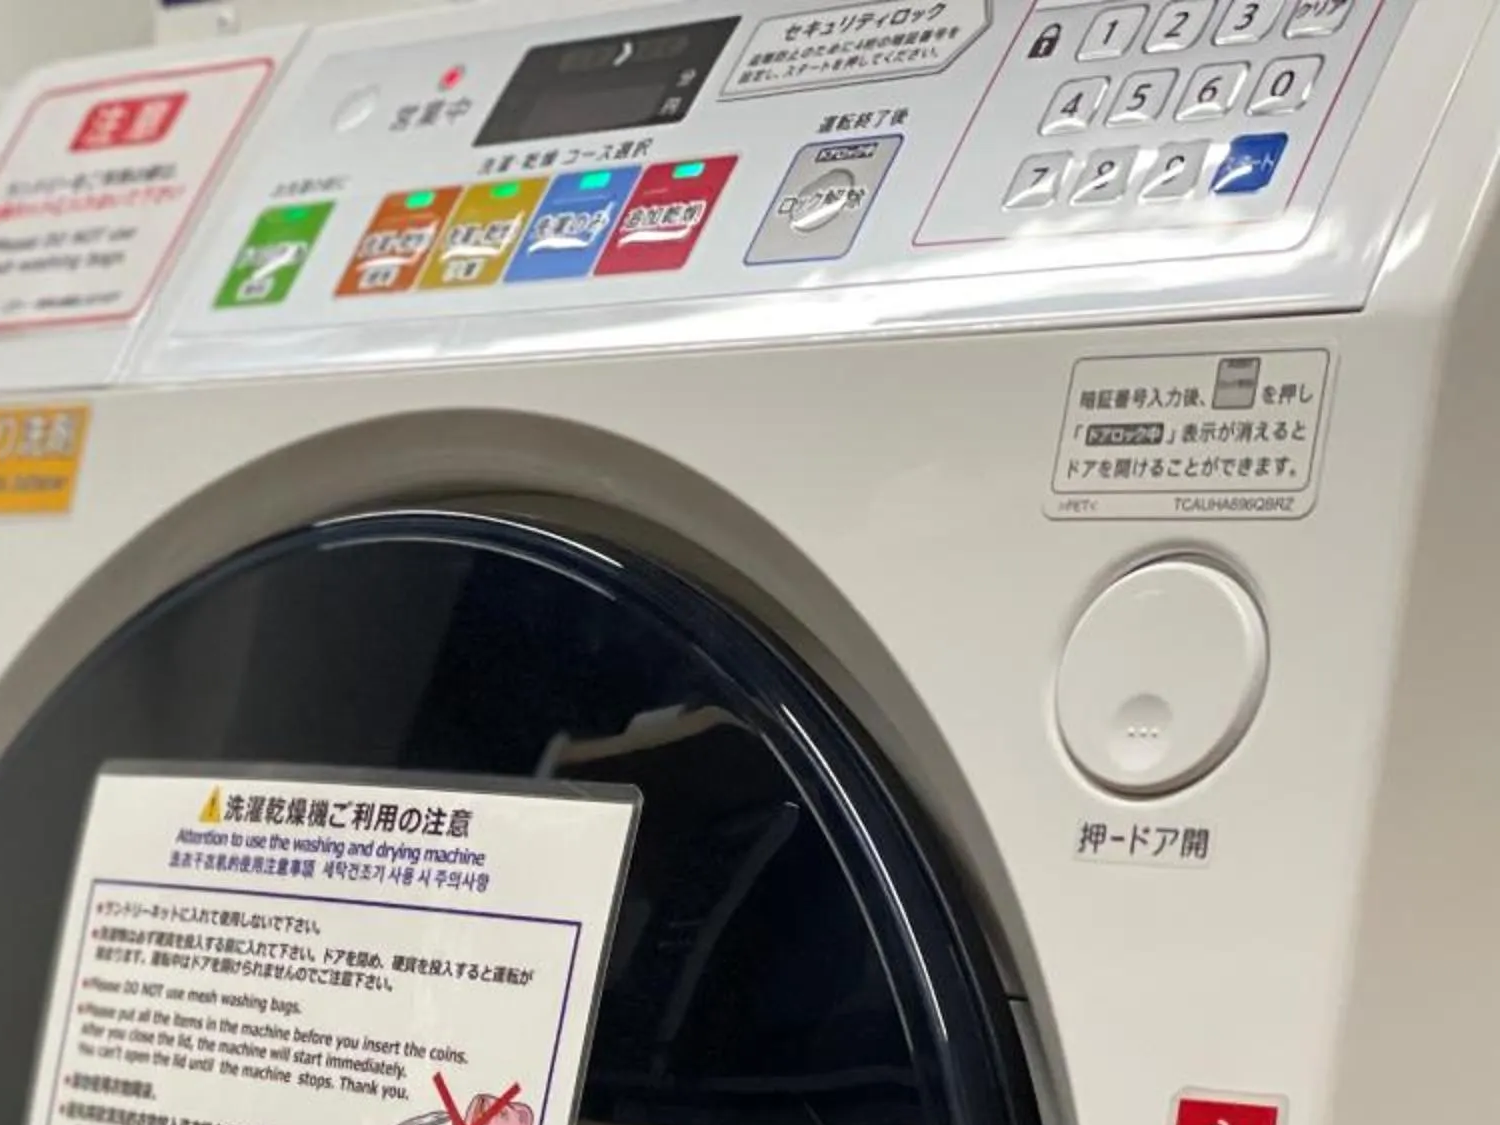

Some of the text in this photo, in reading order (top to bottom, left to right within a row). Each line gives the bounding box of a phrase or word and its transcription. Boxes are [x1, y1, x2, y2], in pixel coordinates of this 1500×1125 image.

[784, 2, 948, 42] セキュリティロック
[1164, 11, 1190, 38] 2
[1234, 2, 1260, 31] 3
[1102, 19, 1120, 45] 1
[1126, 82, 1152, 111] 5
[1197, 75, 1223, 104] 6
[1270, 69, 1295, 98] 0
[1059, 92, 1084, 117] 4
[1260, 383, 1314, 405] を押し
[1066, 457, 1297, 480] ドアを開けることができます。
[224, 794, 474, 838] 洗濯乾燥機ご利用の注意
[176, 829, 487, 867] Attention to use the washing and drying machine
[166, 986, 185, 1001] use
[187, 985, 217, 1004] mesh
[220, 990, 267, 1014] washing
[270, 997, 303, 1017] bags.
[153, 1008, 171, 1026] the
[206, 1014, 218, 1031] in
[220, 1015, 240, 1035] the
[241, 1019, 291, 1042] machine
[293, 1026, 333, 1047] before
[336, 1036, 360, 1052] you
[362, 1035, 402, 1057] insert
[404, 1040, 428, 1059] the
[429, 1045, 469, 1065] coins.
[157, 1029, 175, 1047] the
[197, 1034, 216, 1053] the
[218, 1036, 267, 1059] machine
[269, 1042, 291, 1063] will
[293, 1049, 323, 1068] start
[325, 1052, 408, 1080] immediately.
[219, 1057, 240, 1076] the
[241, 1062, 292, 1084] machine
[297, 1071, 335, 1091] stops.
[339, 1075, 379, 1096] Thank
[381, 1083, 410, 1102] you.
